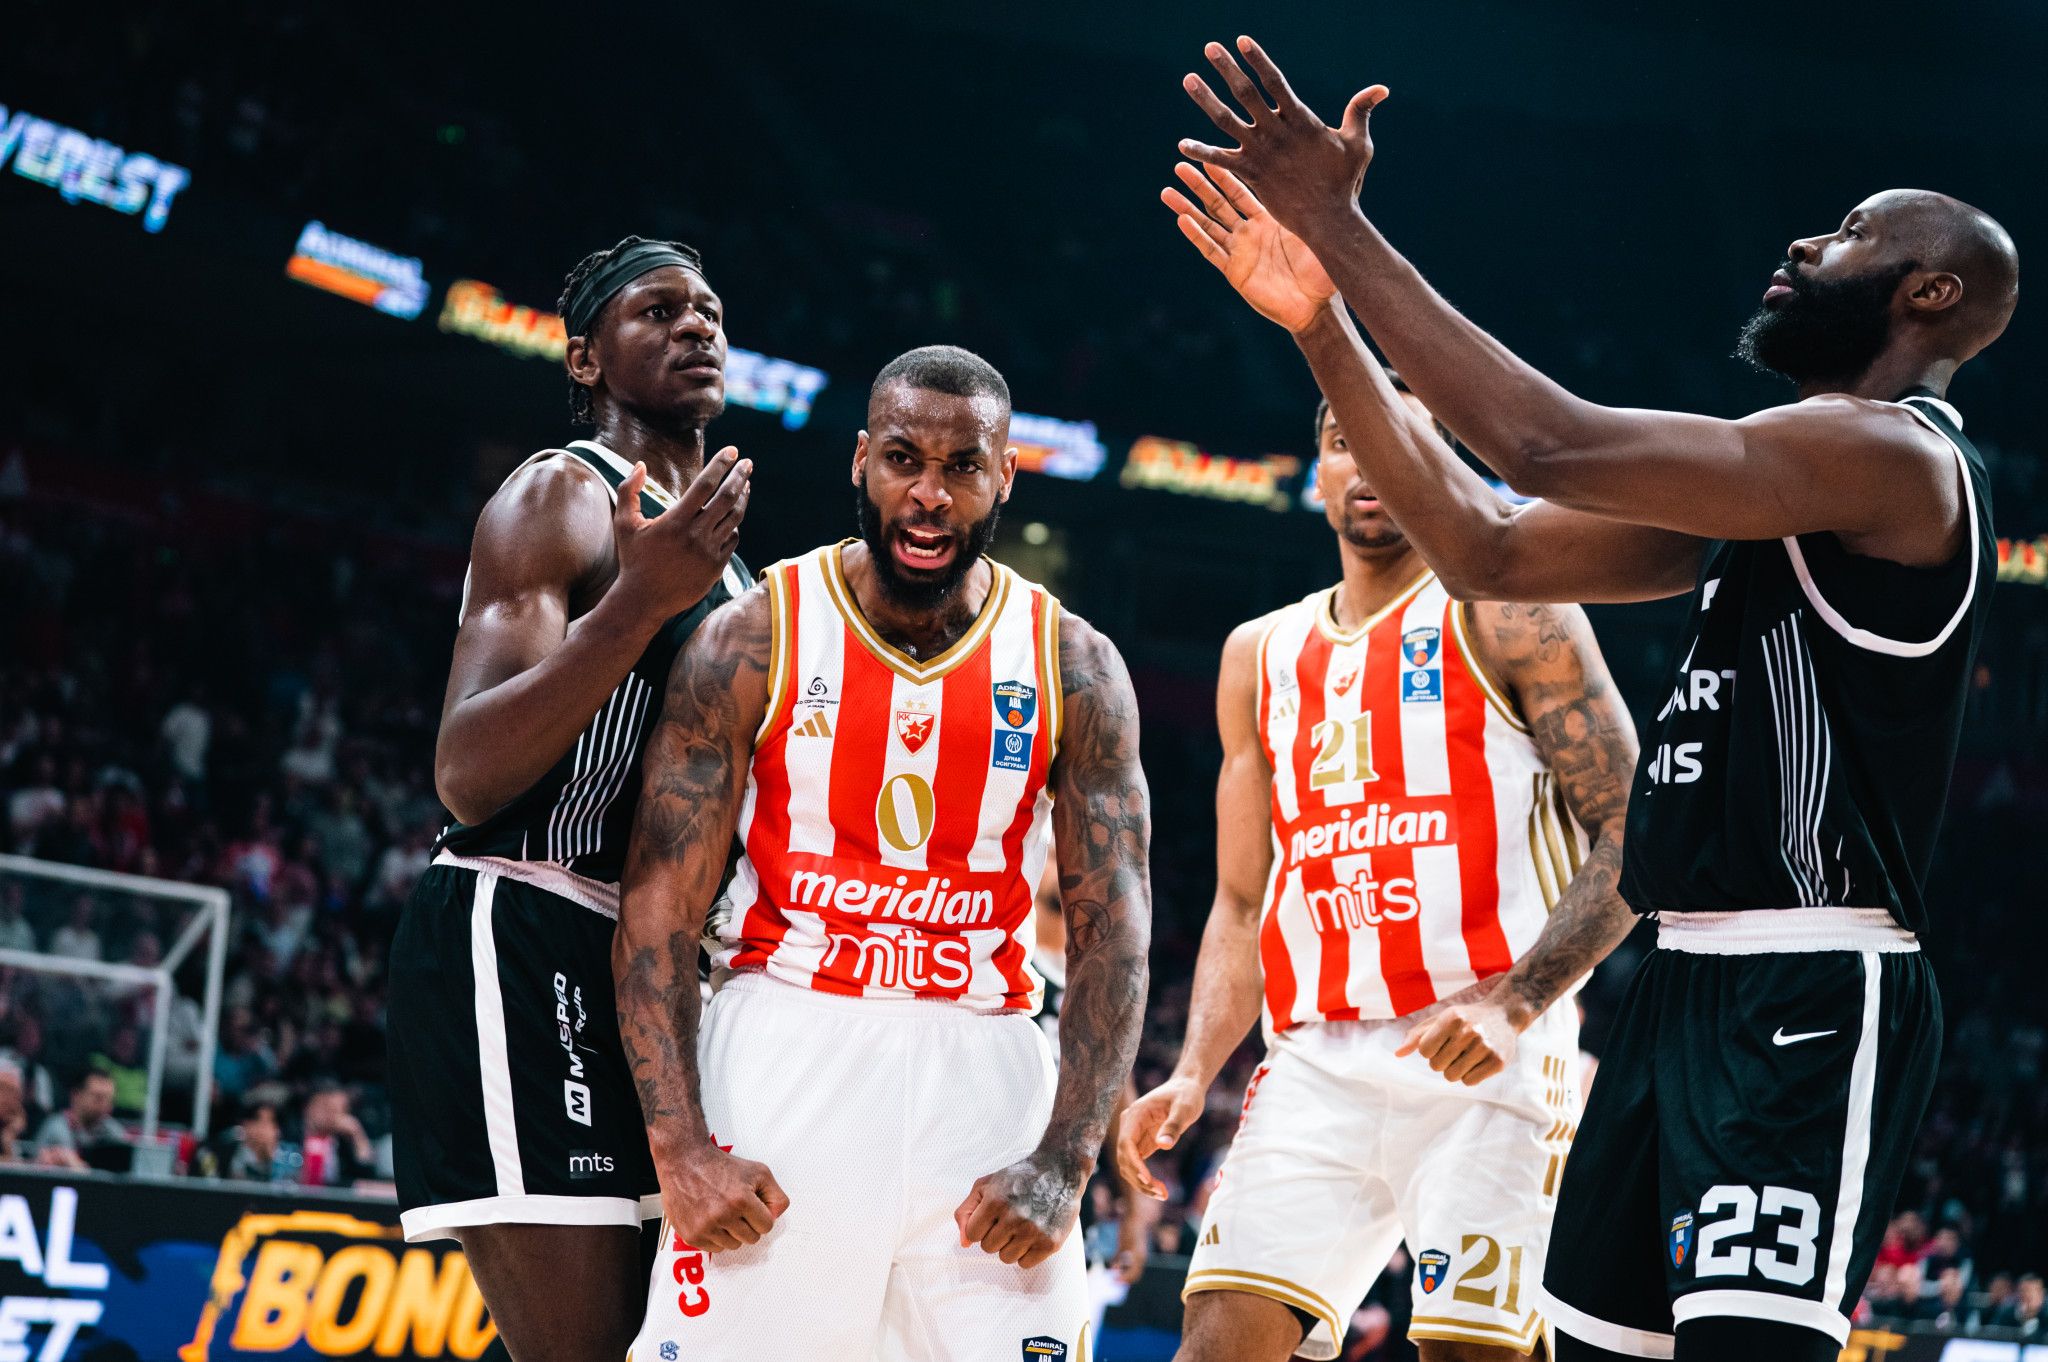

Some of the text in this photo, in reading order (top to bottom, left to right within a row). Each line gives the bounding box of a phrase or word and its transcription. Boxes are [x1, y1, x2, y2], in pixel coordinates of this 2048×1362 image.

[997, 684, 1033, 695] ADMIRAL
[1009, 697, 1022, 709] ABA
[1311, 711, 1379, 791] 21
[876, 773, 935, 852] 0
[789, 870, 993, 925] meridian
[1307, 871, 1419, 932] mts
[822, 929, 969, 988] mts
[570, 1152, 614, 1172] mts
[1695, 1185, 1821, 1286] 23
[1453, 1234, 1523, 1316] 21
[1028, 1340, 1064, 1351] ADMIRAL
